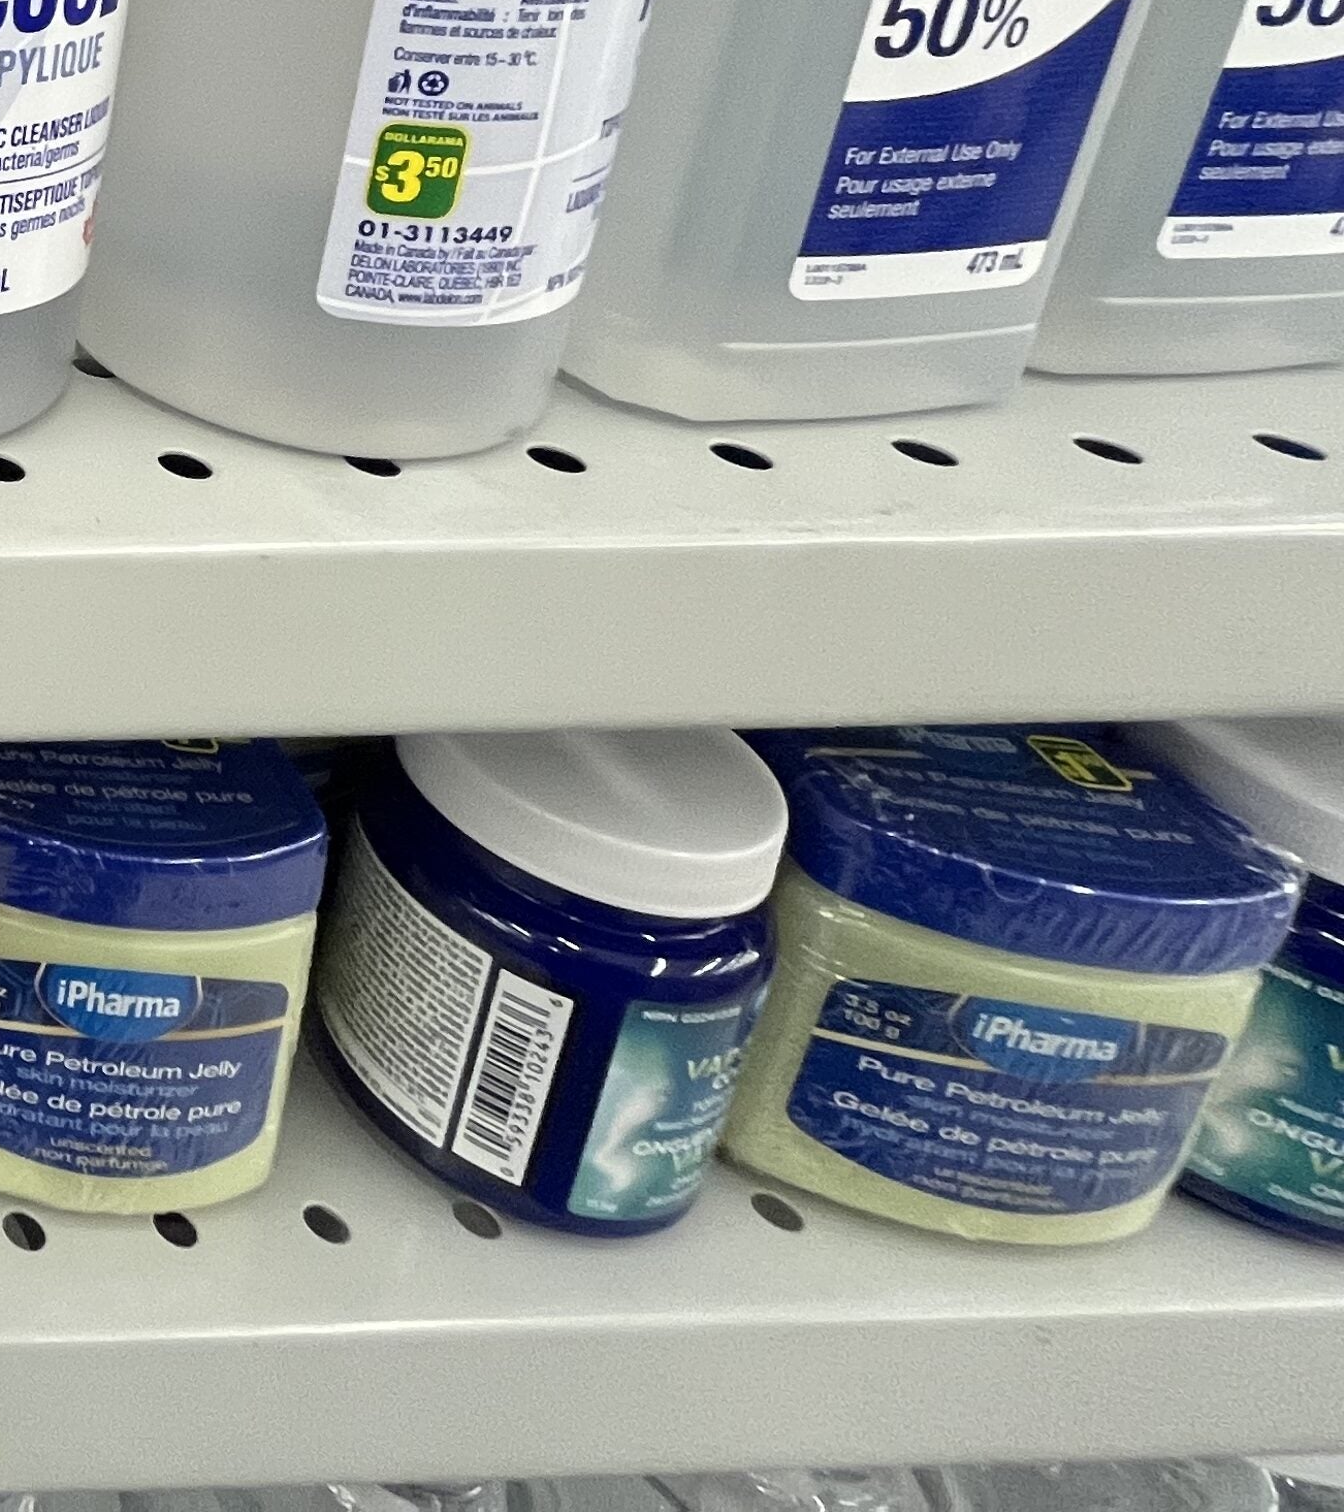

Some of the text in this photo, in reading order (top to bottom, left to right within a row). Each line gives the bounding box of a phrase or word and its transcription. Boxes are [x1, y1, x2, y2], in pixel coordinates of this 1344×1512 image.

[11, 111, 82, 147] CLEANSER
[845, 147, 875, 165] For
[880, 143, 948, 164] External
[951, 142, 983, 162] Use
[359, 220, 512, 244] 01-3113449
[57, 980, 181, 1019] iPharma
[971, 1012, 1118, 1061] iPharma
[46, 1050, 182, 1079] Petroleum
[48, 1093, 81, 1113] de
[89, 1099, 182, 1121] pétrole
[188, 1100, 241, 1123] pure
